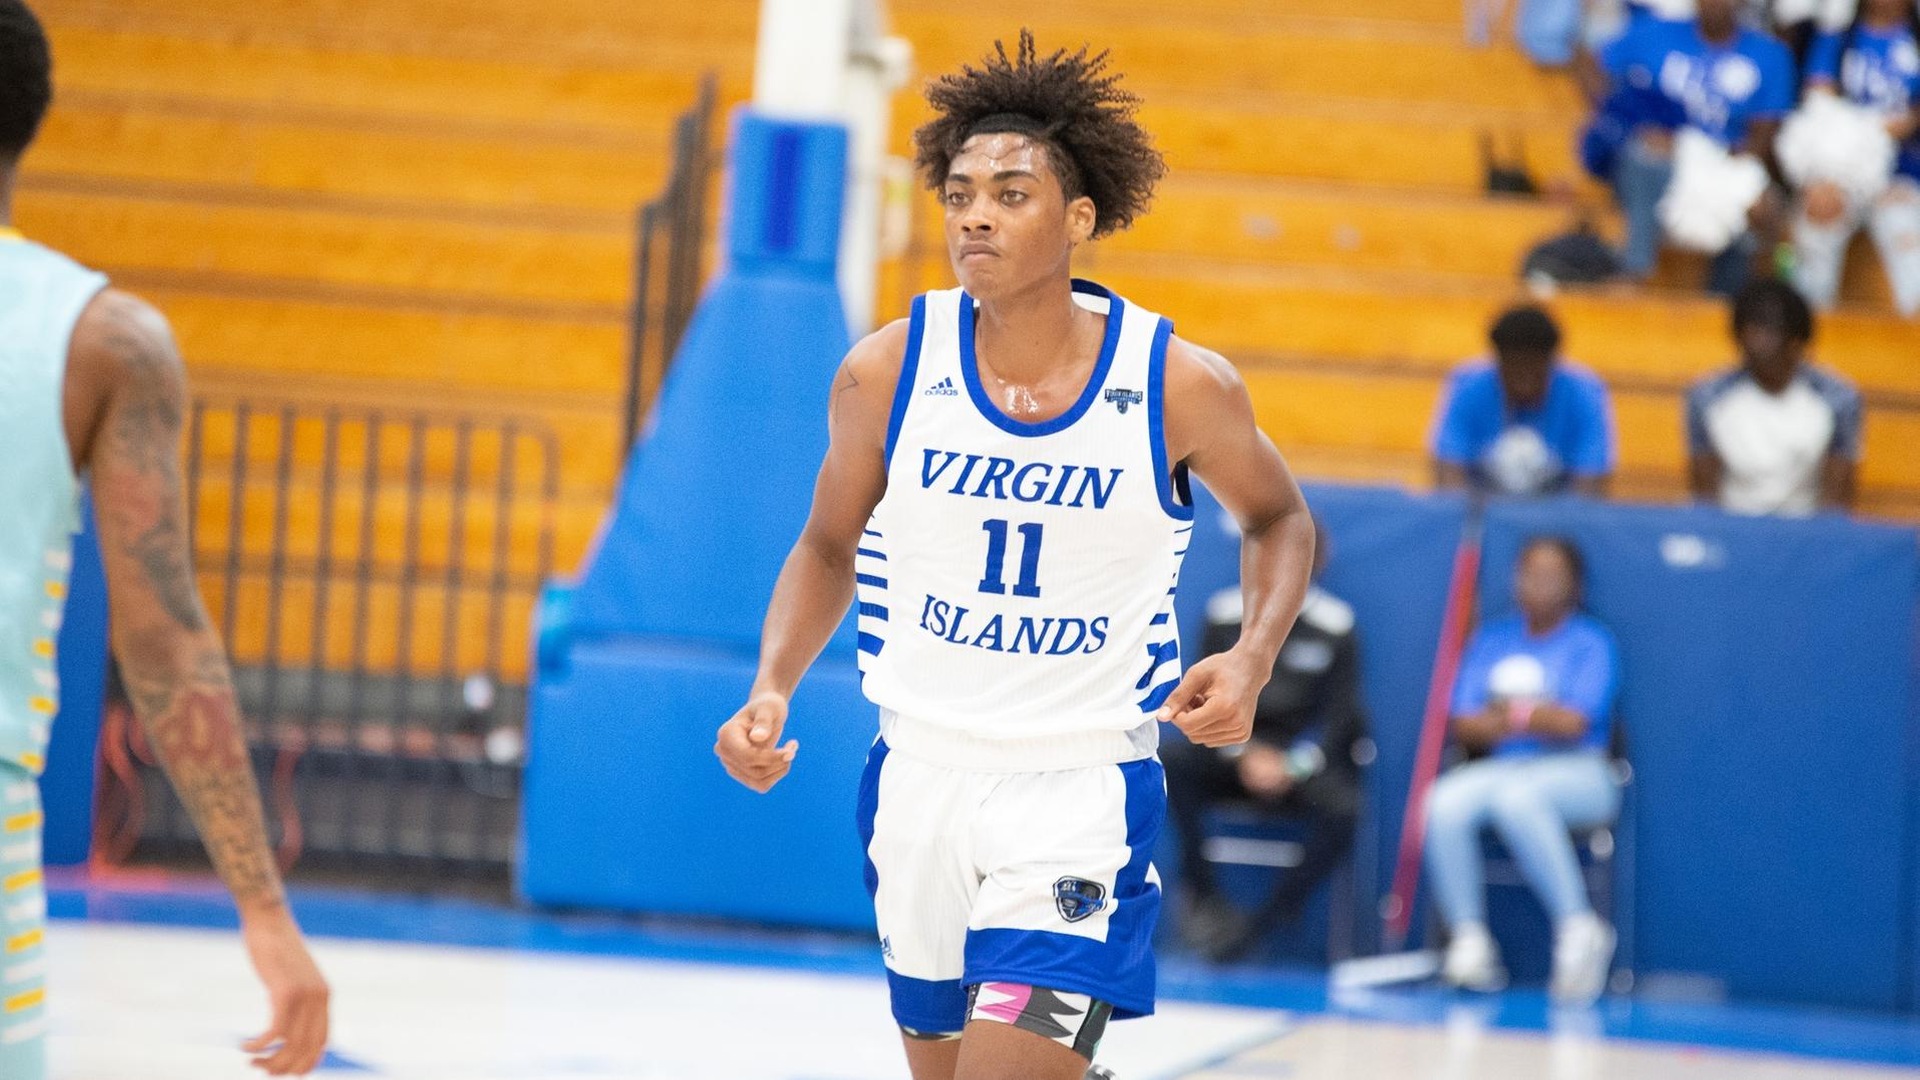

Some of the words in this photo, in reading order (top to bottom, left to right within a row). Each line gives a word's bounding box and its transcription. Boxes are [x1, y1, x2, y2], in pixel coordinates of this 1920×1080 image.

[921, 448, 1124, 510] VIRGIN
[977, 518, 1044, 598] 11
[919, 594, 1109, 656] ISLANDS
